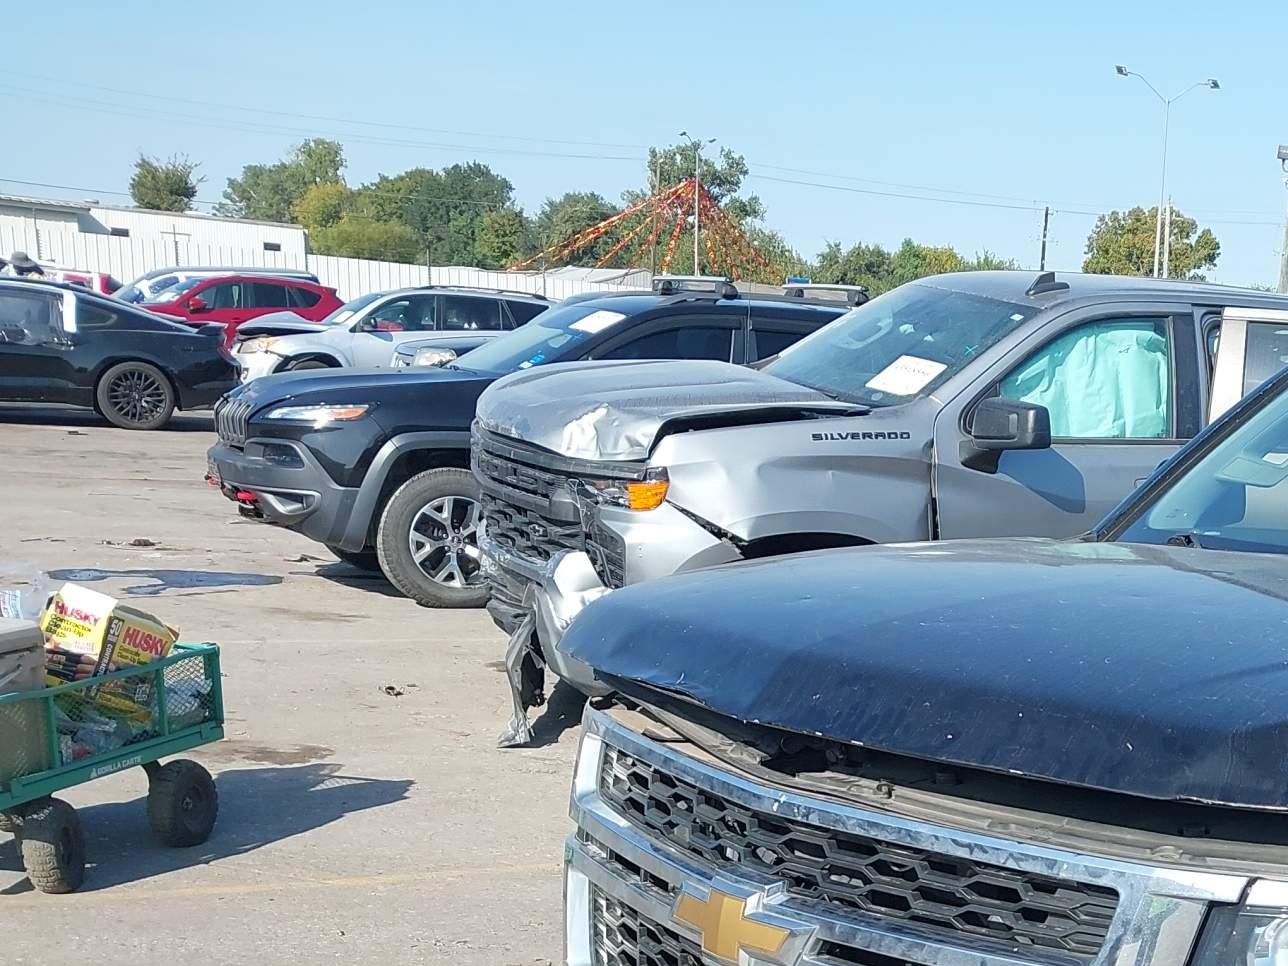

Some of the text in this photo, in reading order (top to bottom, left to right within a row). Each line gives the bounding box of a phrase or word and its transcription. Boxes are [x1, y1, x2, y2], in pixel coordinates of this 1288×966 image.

[811, 431, 912, 441] SILVERADO
[55, 600, 101, 626] HUSKY
[110, 619, 123, 636] 50
[123, 626, 168, 657] HUSKY
